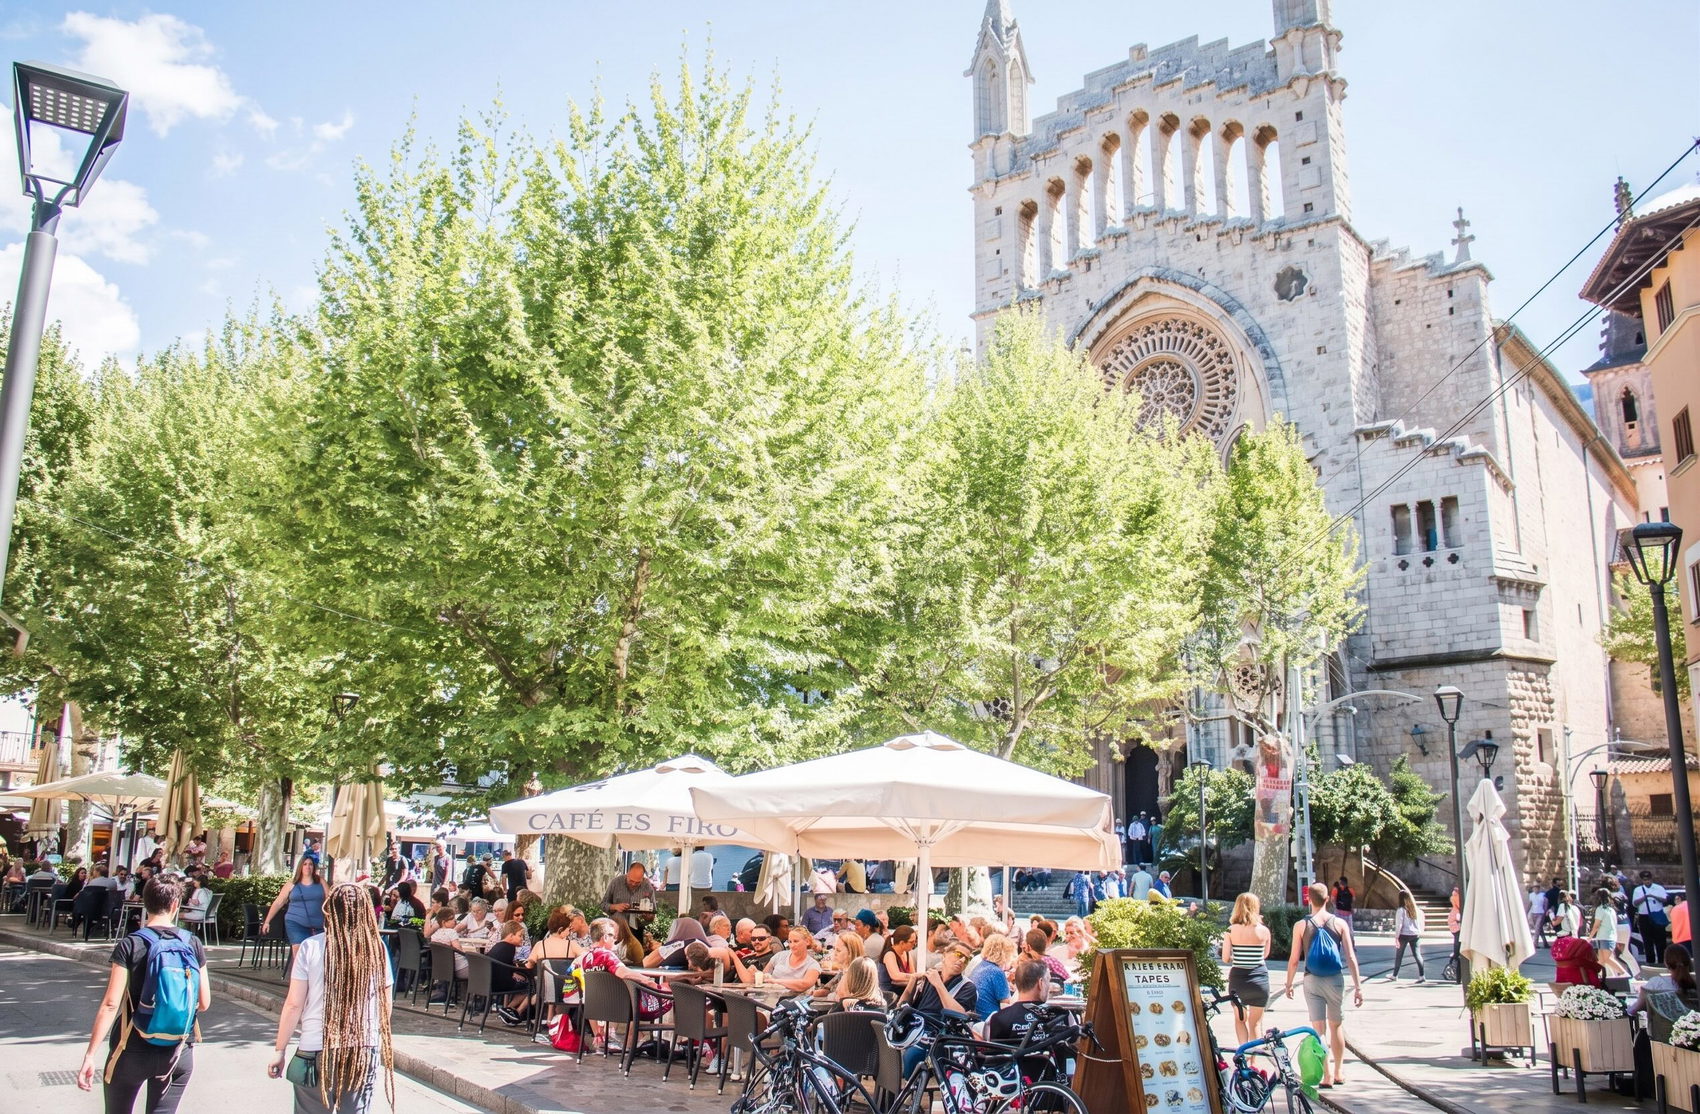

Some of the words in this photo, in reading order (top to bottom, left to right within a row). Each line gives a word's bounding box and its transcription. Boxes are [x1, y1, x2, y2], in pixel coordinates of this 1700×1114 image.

[528, 809, 604, 831] CAFÉ
[615, 813, 651, 832] ES
[1134, 975, 1171, 984] TAPES
